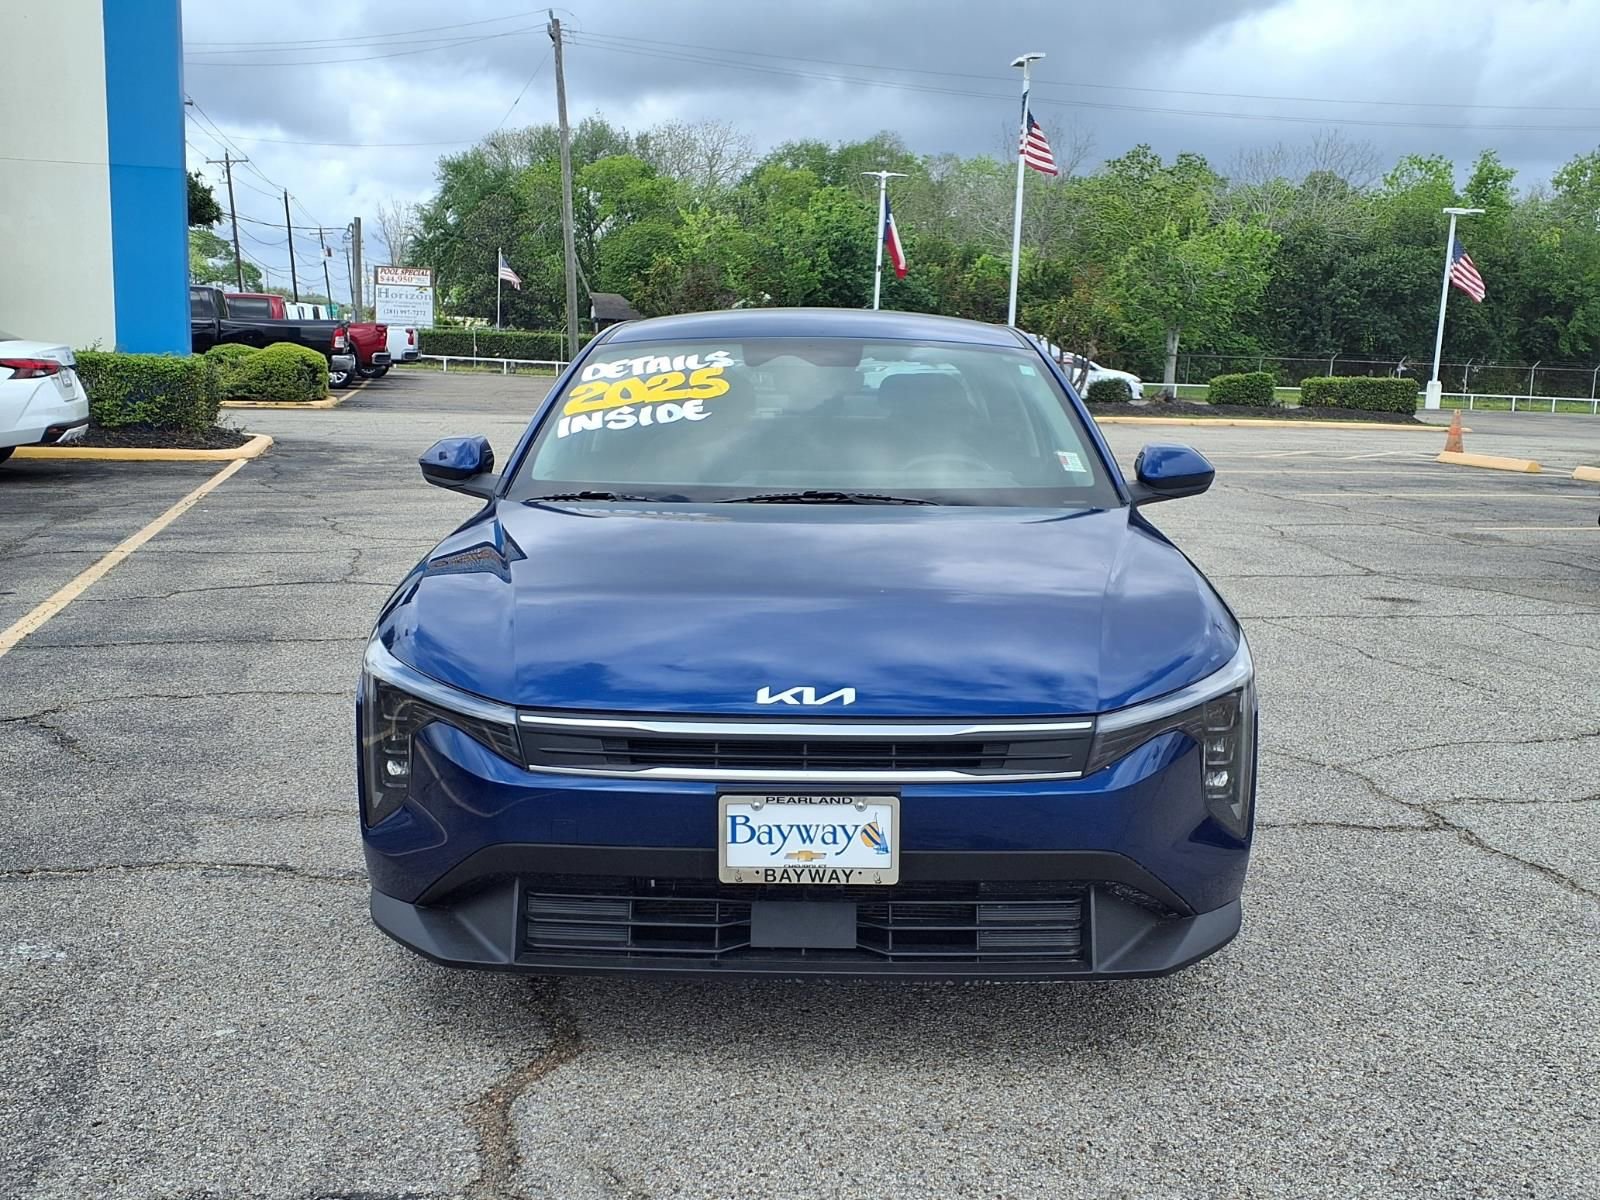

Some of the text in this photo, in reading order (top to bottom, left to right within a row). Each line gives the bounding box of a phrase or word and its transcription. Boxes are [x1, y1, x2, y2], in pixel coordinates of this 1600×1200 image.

[401, 269, 430, 277] SPECIAL
[377, 287, 432, 301] Horizon
[581, 350, 735, 382] DETAILS
[563, 367, 730, 416] 2025
[557, 399, 712, 439] INSIDE
[756, 686, 856, 706] KIA
[765, 796, 853, 805] PEARLAND
[727, 814, 861, 856] Bayway
[764, 868, 854, 883] BAYWAY
